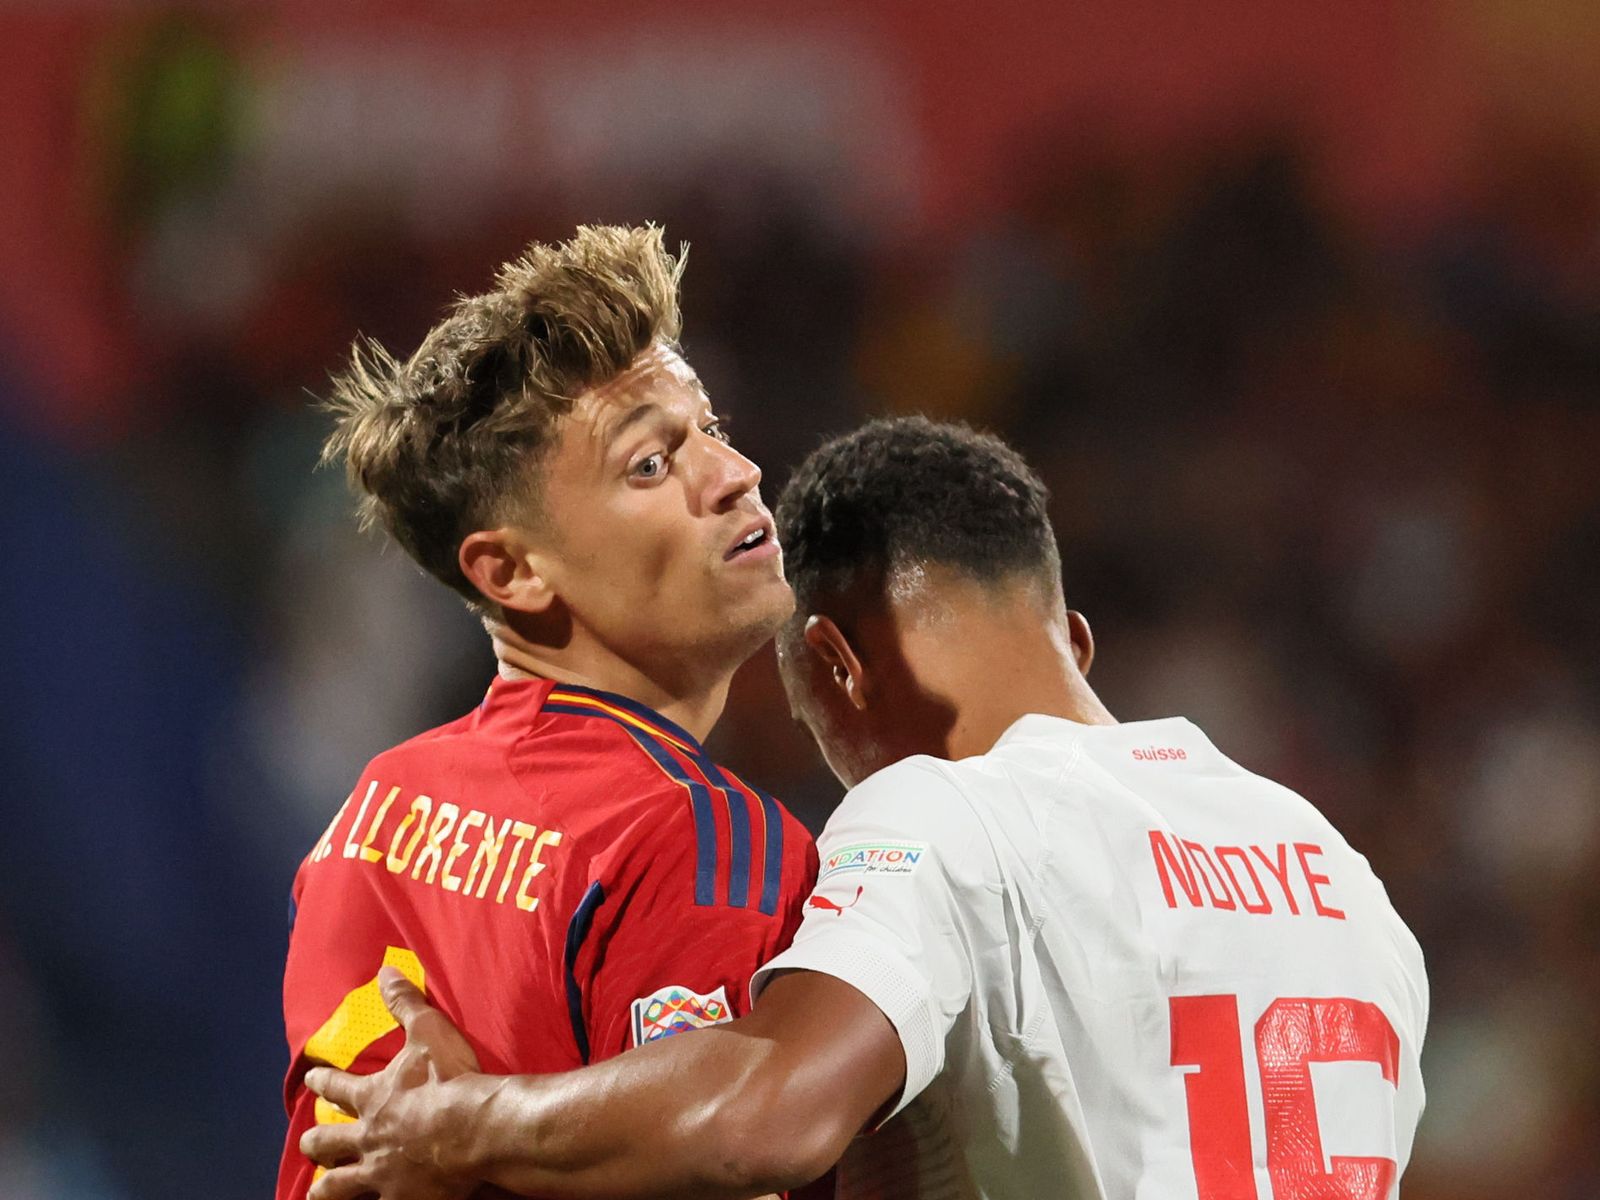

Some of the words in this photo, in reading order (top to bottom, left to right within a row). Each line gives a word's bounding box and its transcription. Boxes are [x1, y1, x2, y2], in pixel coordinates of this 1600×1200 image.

[1132, 745, 1187, 761] suisse
[342, 780, 562, 912] LLORENTE
[1148, 830, 1346, 920] NDOYE
